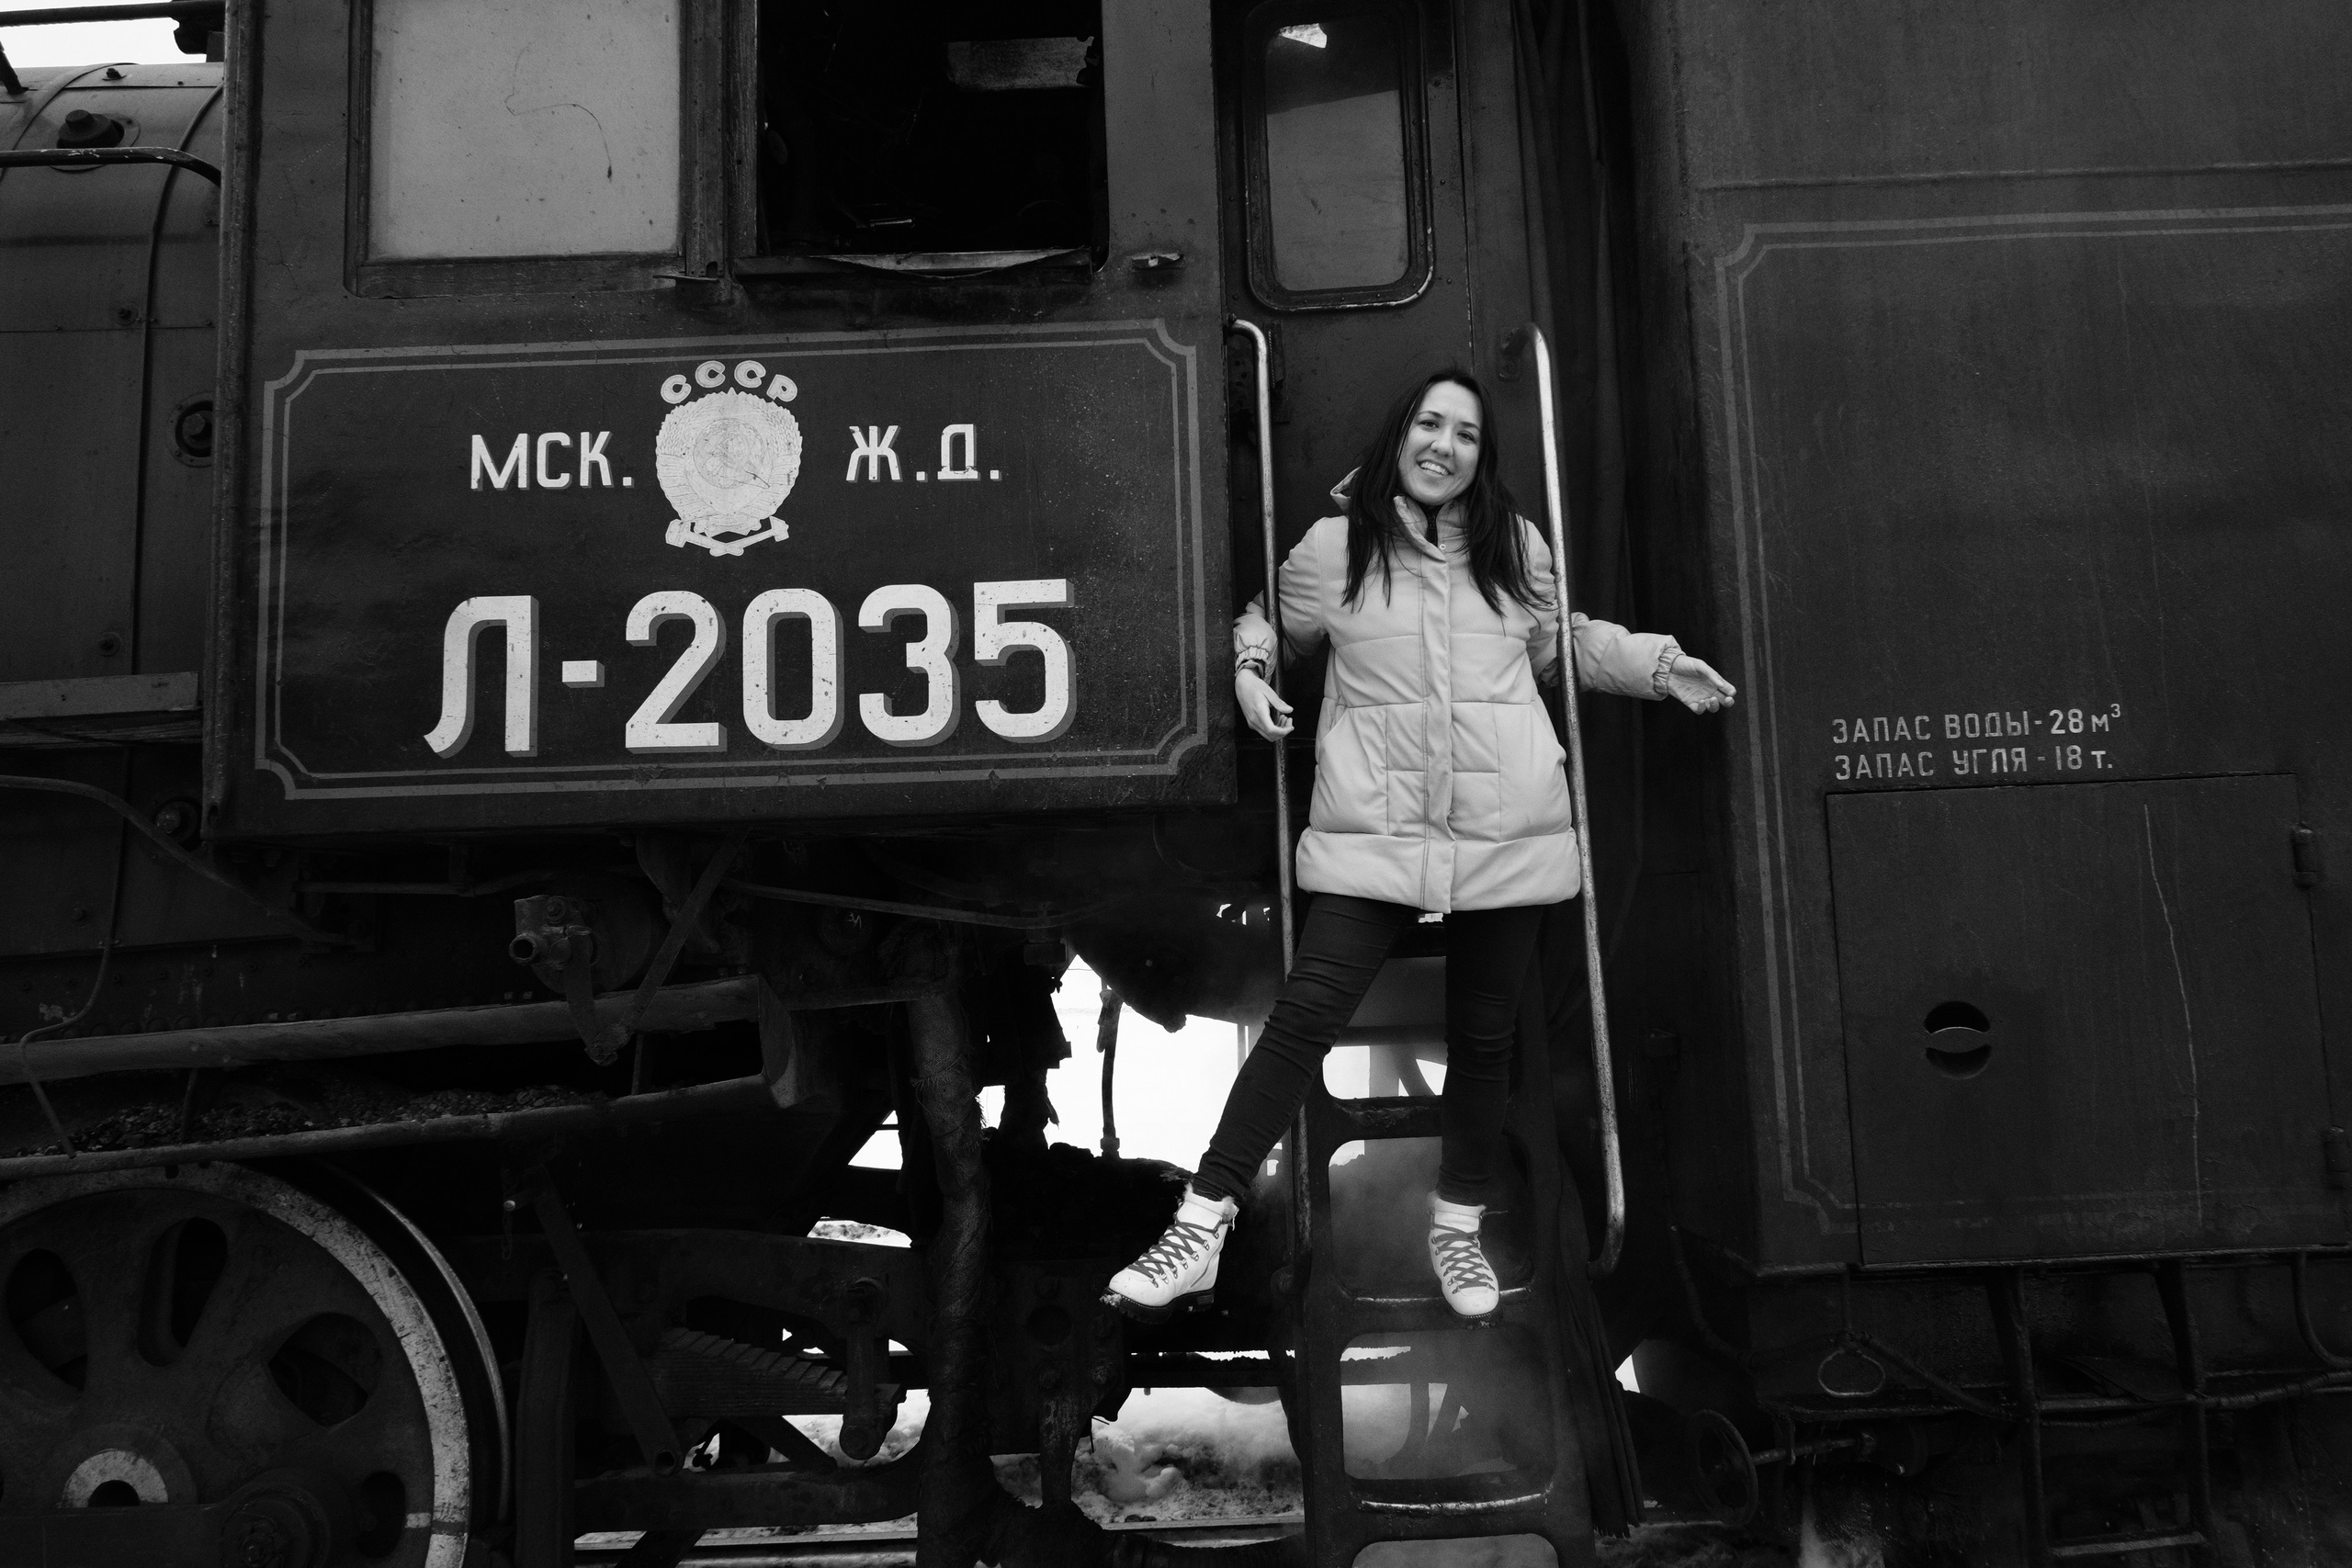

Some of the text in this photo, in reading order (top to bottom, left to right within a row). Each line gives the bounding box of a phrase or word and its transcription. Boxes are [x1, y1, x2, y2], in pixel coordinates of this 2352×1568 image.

[660, 359, 798, 404] СССР
[470, 431, 635, 491] МСК.
[424, 578, 1076, 759] Л-2035
[1832, 715, 1931, 744] ЗАПАС
[1834, 751, 1934, 781] ЗАПАС
